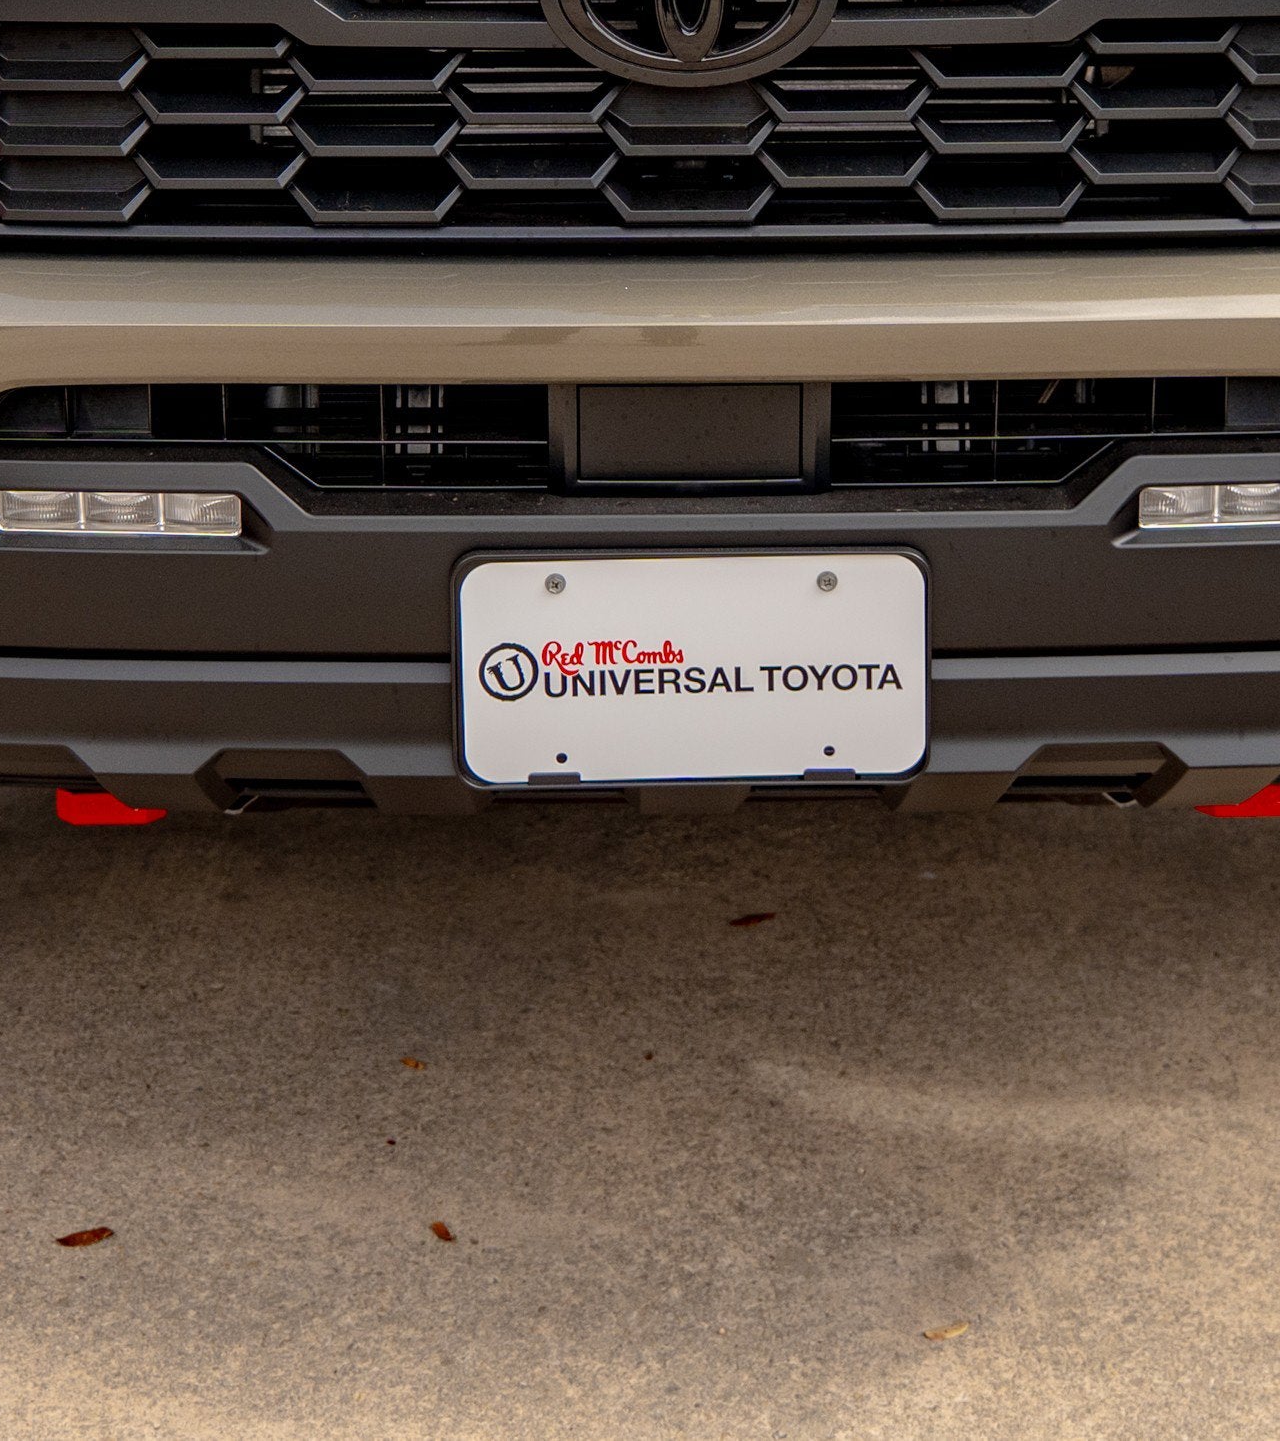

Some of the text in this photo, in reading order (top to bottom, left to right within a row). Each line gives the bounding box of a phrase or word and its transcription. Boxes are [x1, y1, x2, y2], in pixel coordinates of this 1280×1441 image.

[542, 640, 684, 676] Red McCombs
[544, 664, 903, 698] UNIVERSAL TOYOTA
